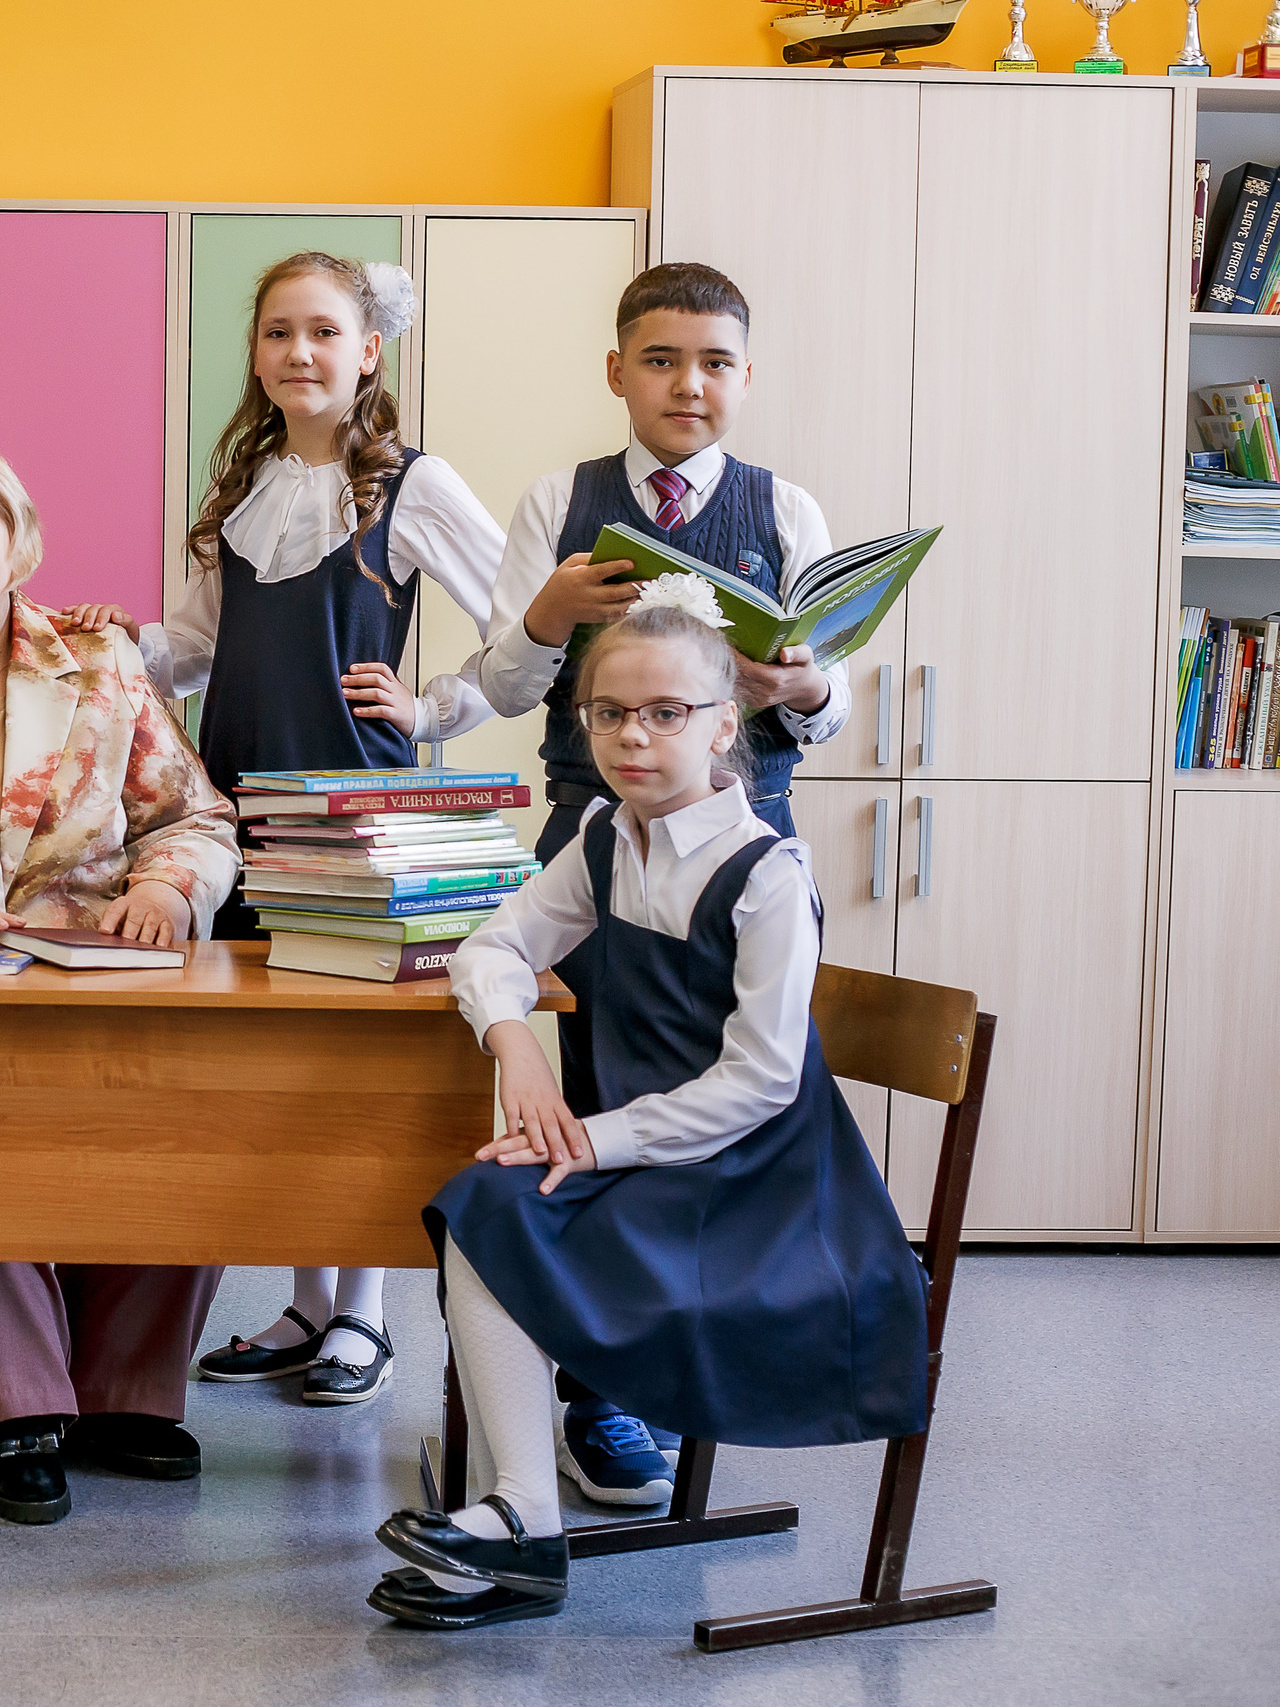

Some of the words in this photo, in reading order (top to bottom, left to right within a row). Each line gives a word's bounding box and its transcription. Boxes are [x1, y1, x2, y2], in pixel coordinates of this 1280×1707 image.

[1224, 241, 1246, 282] НОВЫЙ
[822, 552, 912, 614] МОРДОВИЯ
[1263, 676, 1272, 698] УХОД
[1257, 699, 1270, 756] ЕЖЕДНЕВНЫЙ
[1208, 737, 1217, 762] 365
[343, 780, 384, 789] ПРАВИЛА
[387, 777, 440, 788] ПОВЕДЕНИЯ
[390, 795, 433, 808] КНИГА
[435, 792, 492, 807] КРАСНАЯ
[423, 921, 470, 935] MORDOVIA
